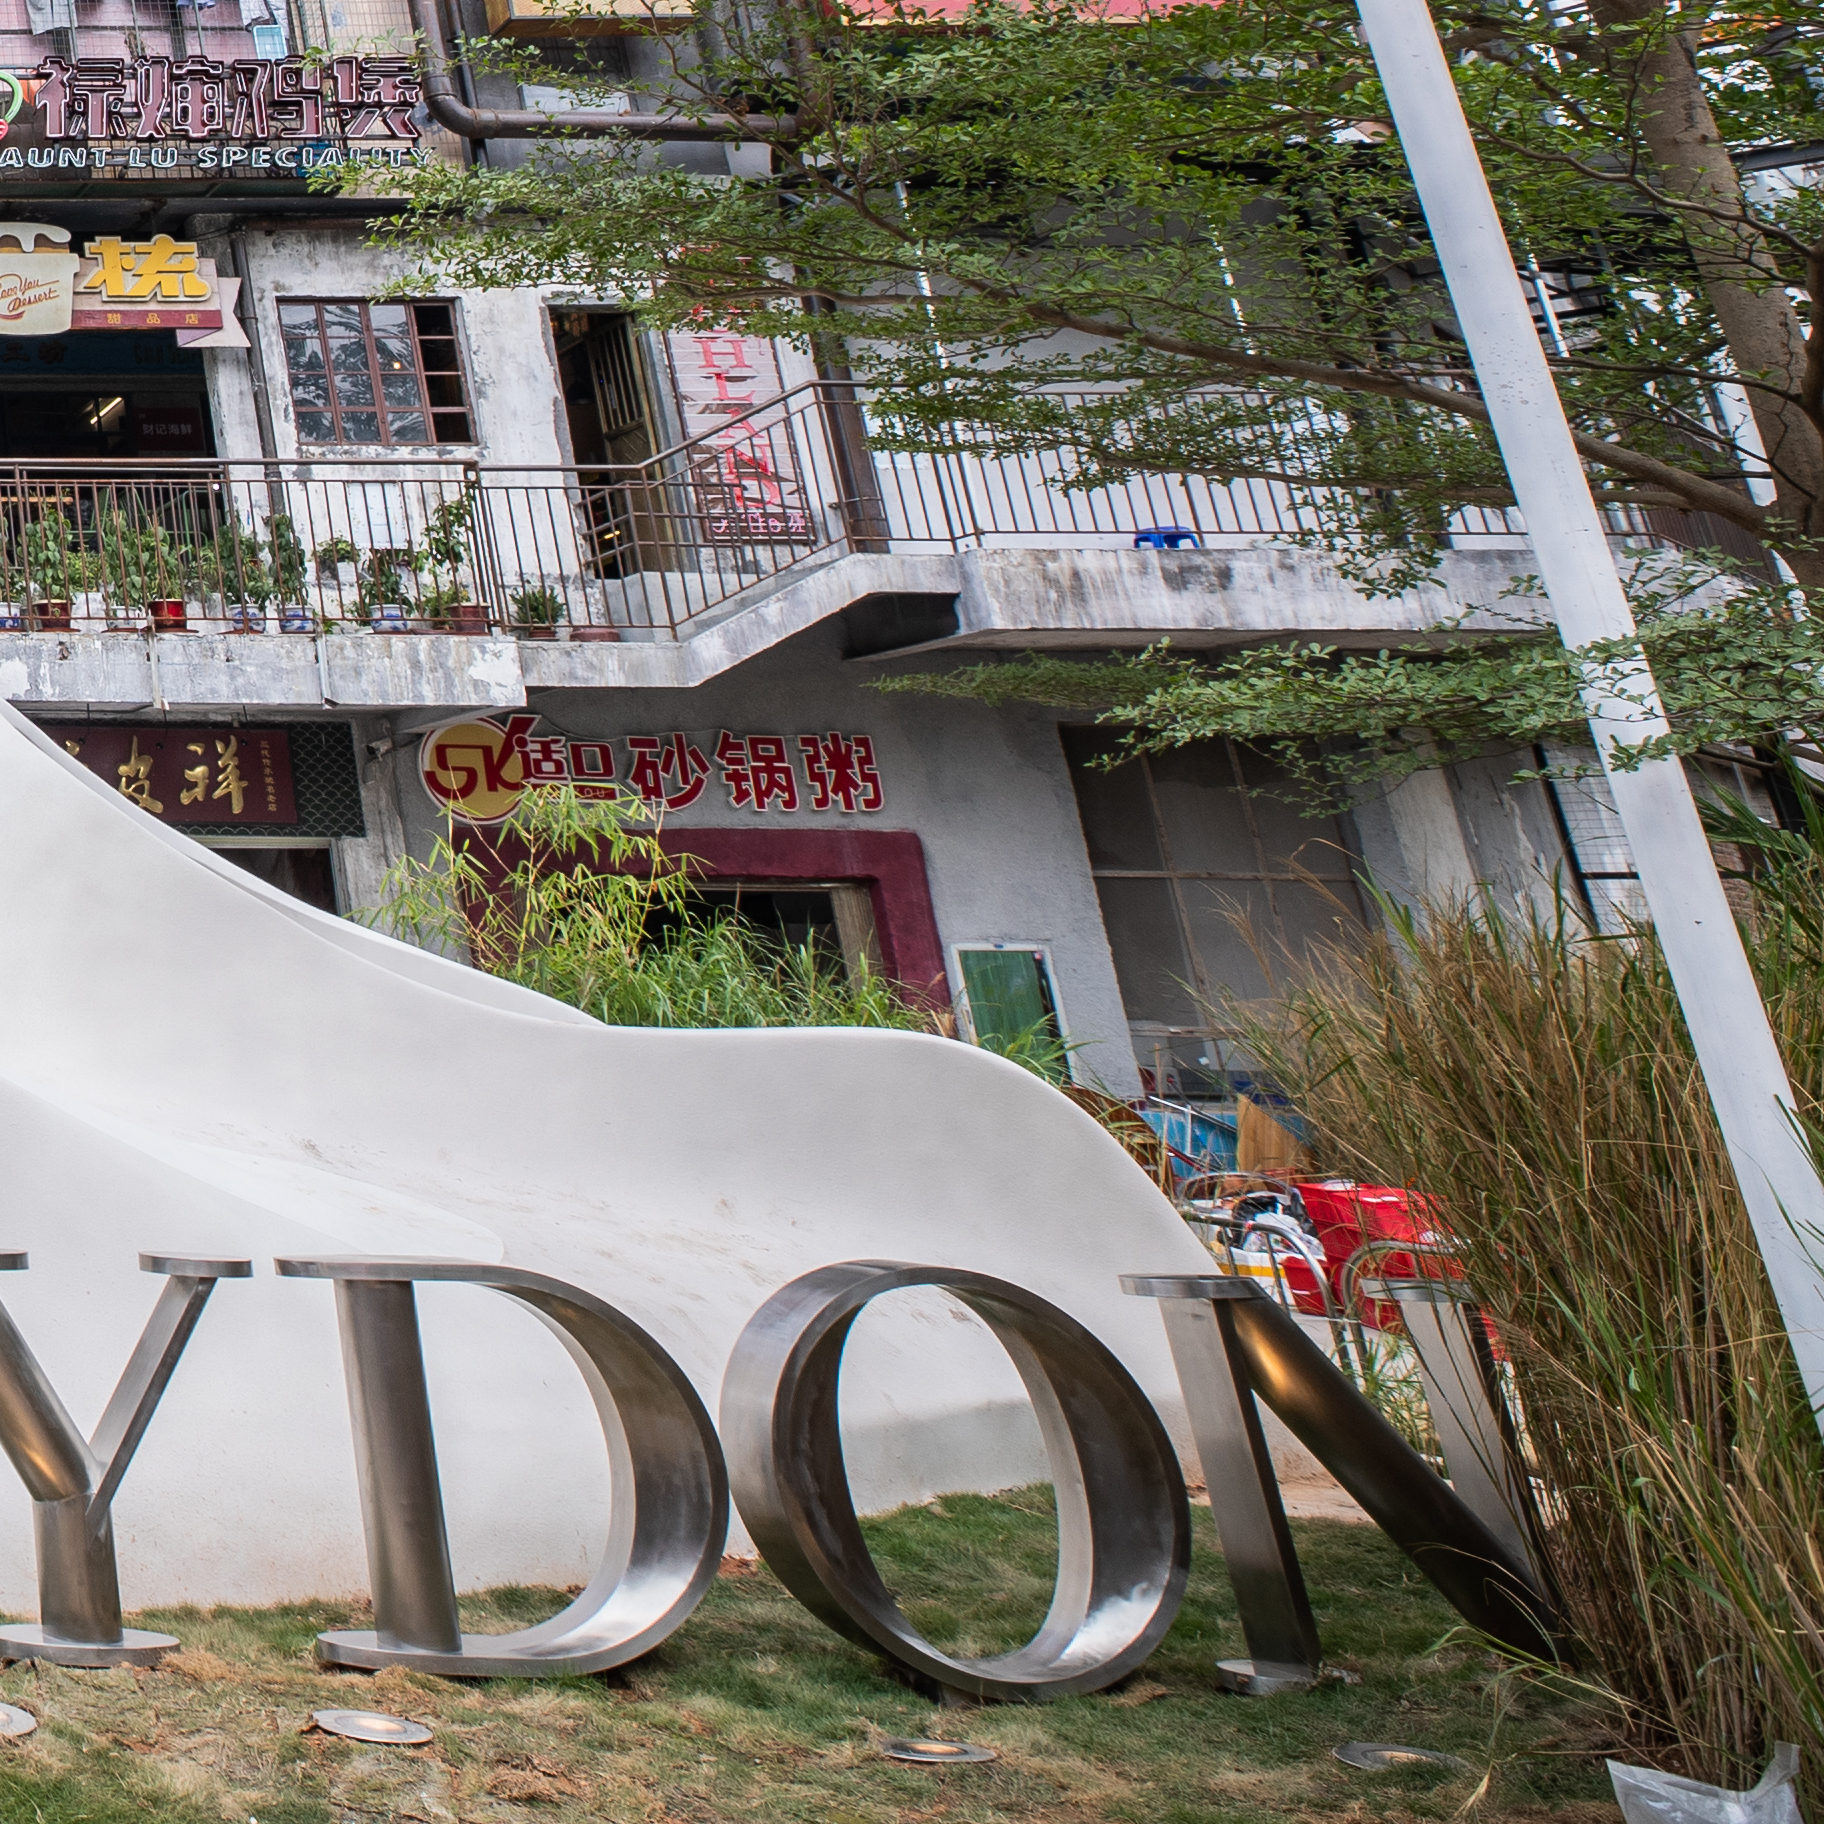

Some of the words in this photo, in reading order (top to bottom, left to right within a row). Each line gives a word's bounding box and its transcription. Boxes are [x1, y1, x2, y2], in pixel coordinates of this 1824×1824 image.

[129, 146, 180, 169] LU
[7, 286, 61, 312] Dessert
[64, 734, 250, 815] 皮祥
[625, 729, 885, 813] 砂锅粥
